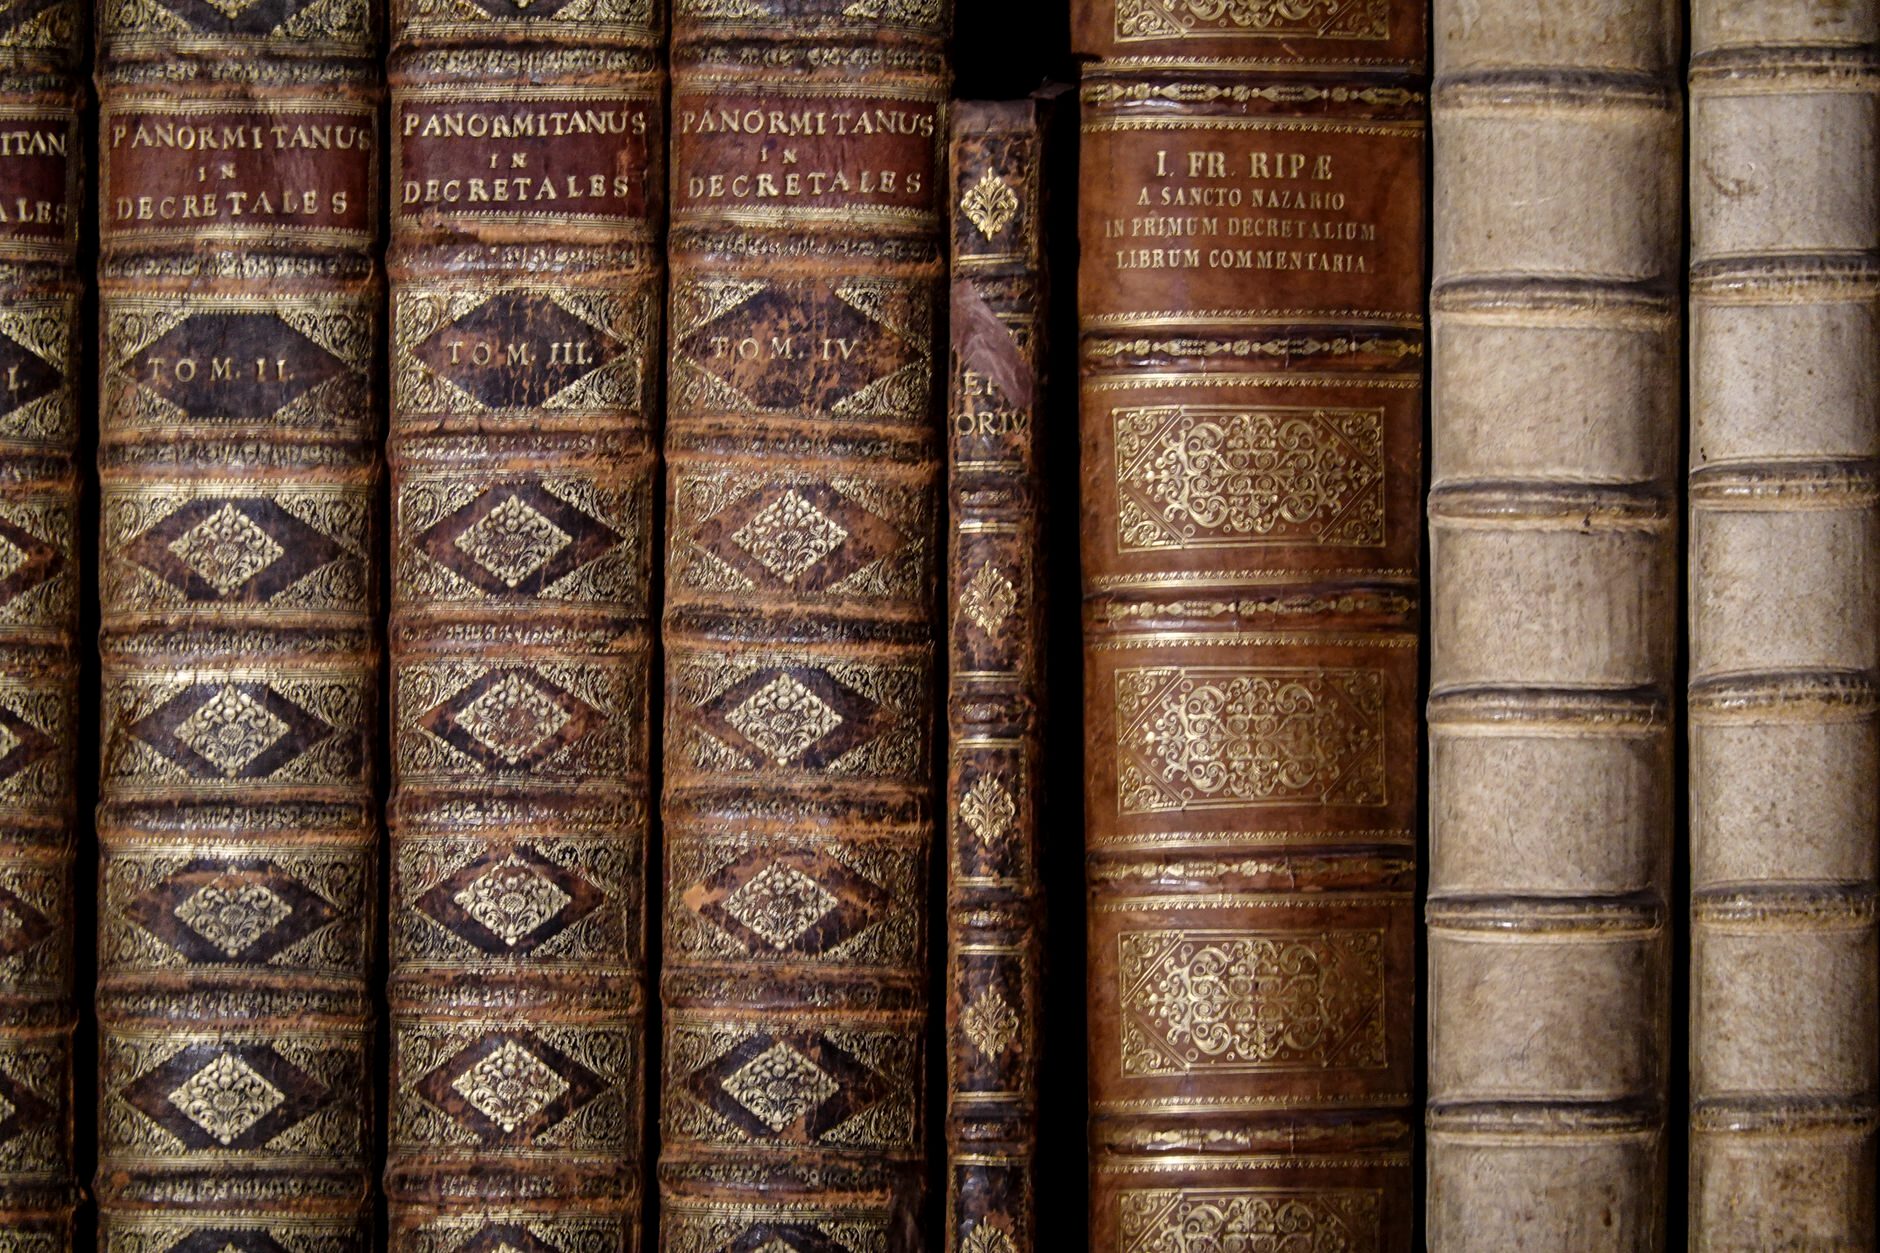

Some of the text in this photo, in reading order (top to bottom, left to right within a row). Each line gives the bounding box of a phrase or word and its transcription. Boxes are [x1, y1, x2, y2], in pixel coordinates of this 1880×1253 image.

[403, 110, 646, 138] PANORMITANUS
[682, 109, 934, 136] PANORMITANUS
[113, 122, 371, 151] PANORMITANUS
[489, 152, 528, 169] IN
[760, 148, 798, 164] IN
[198, 162, 236, 182] IN
[688, 170, 922, 199] DECRETALES
[402, 175, 629, 204] DECRETALES
[1136, 186, 1345, 210] A SANCTO NAZARIO
[116, 191, 348, 220] DECRETALES
[1104, 217, 1375, 241] IN PRIMUM DECRETALIUM
[1116, 249, 1200, 270] LIBRUM
